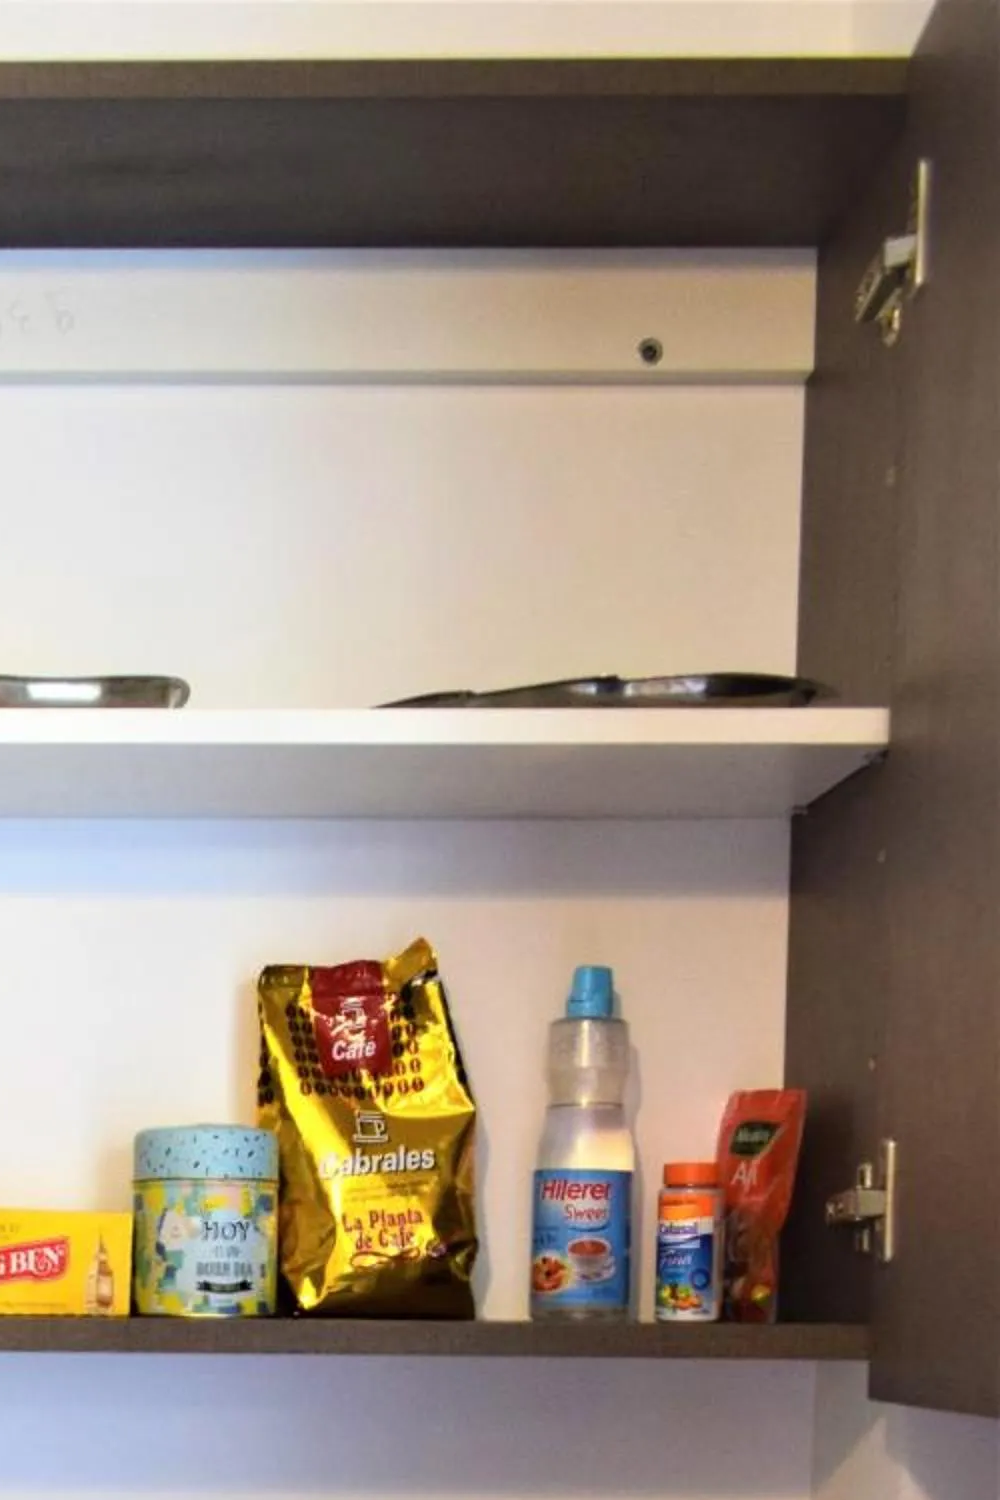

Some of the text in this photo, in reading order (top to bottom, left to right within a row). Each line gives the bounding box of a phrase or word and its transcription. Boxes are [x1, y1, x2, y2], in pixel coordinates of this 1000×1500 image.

[319, 1144, 436, 1179] Cabrales
[202, 1221, 250, 1241] HOY
[341, 1208, 424, 1232] La Planta
[9, 1246, 61, 1276] BEN
